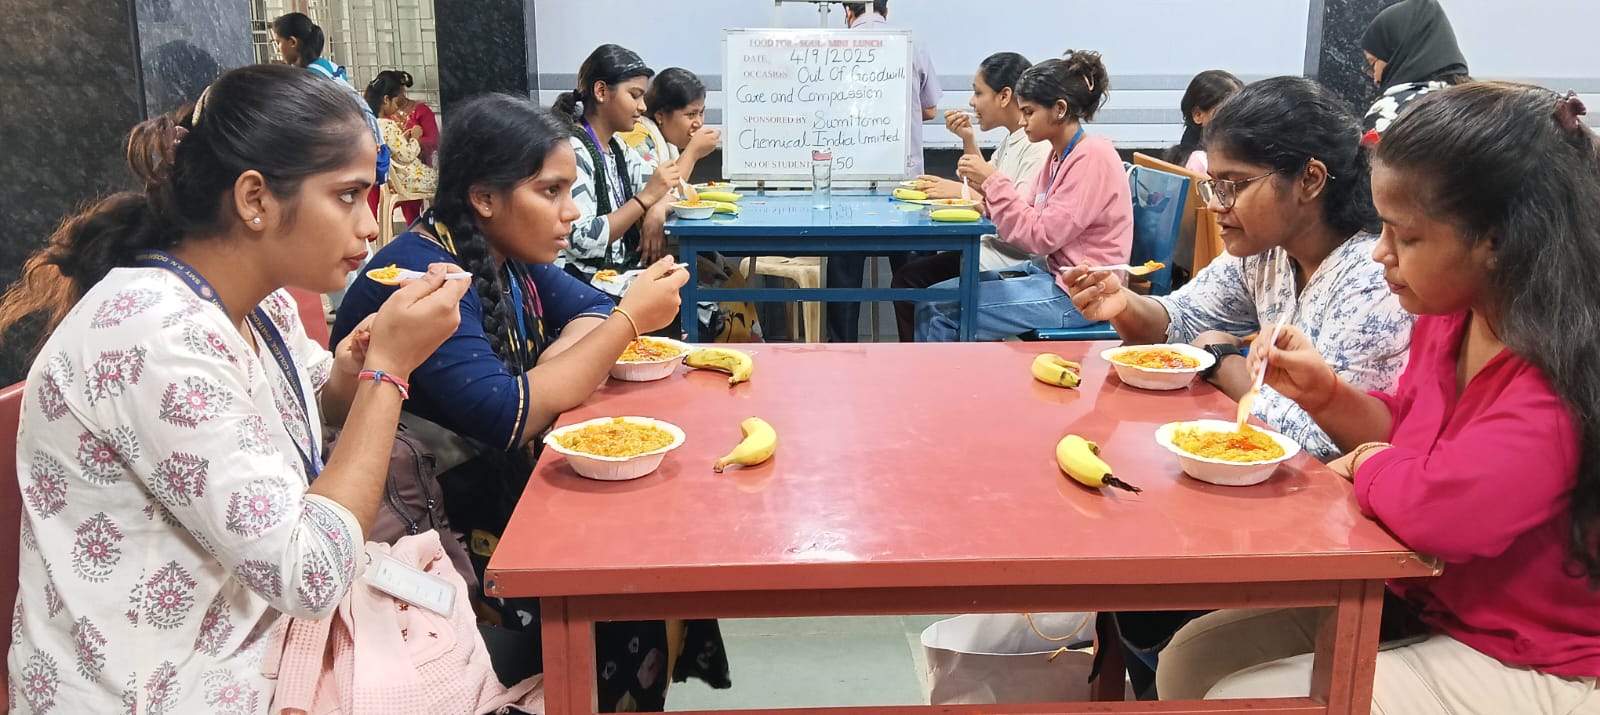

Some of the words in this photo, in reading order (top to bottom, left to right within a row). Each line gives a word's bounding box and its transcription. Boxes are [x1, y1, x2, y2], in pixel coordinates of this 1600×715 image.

[750, 39, 774, 47] FOOD
[853, 39, 884, 47] LUNCH
[790, 48, 876, 65] 4/9/2025
[797, 66, 824, 83] Out
[829, 65, 847, 81] Of
[735, 84, 767, 103] Care
[770, 87, 794, 103] and
[798, 84, 883, 107] Compassion
[743, 115, 797, 124] SPONSORED
[798, 115, 807, 124] BY
[812, 110, 891, 130] Sumitomo
[738, 129, 811, 150] Chemical
[812, 130, 856, 147] India
[744, 160, 757, 168] NO
[758, 160, 770, 168] OF
[831, 156, 854, 170] 50
